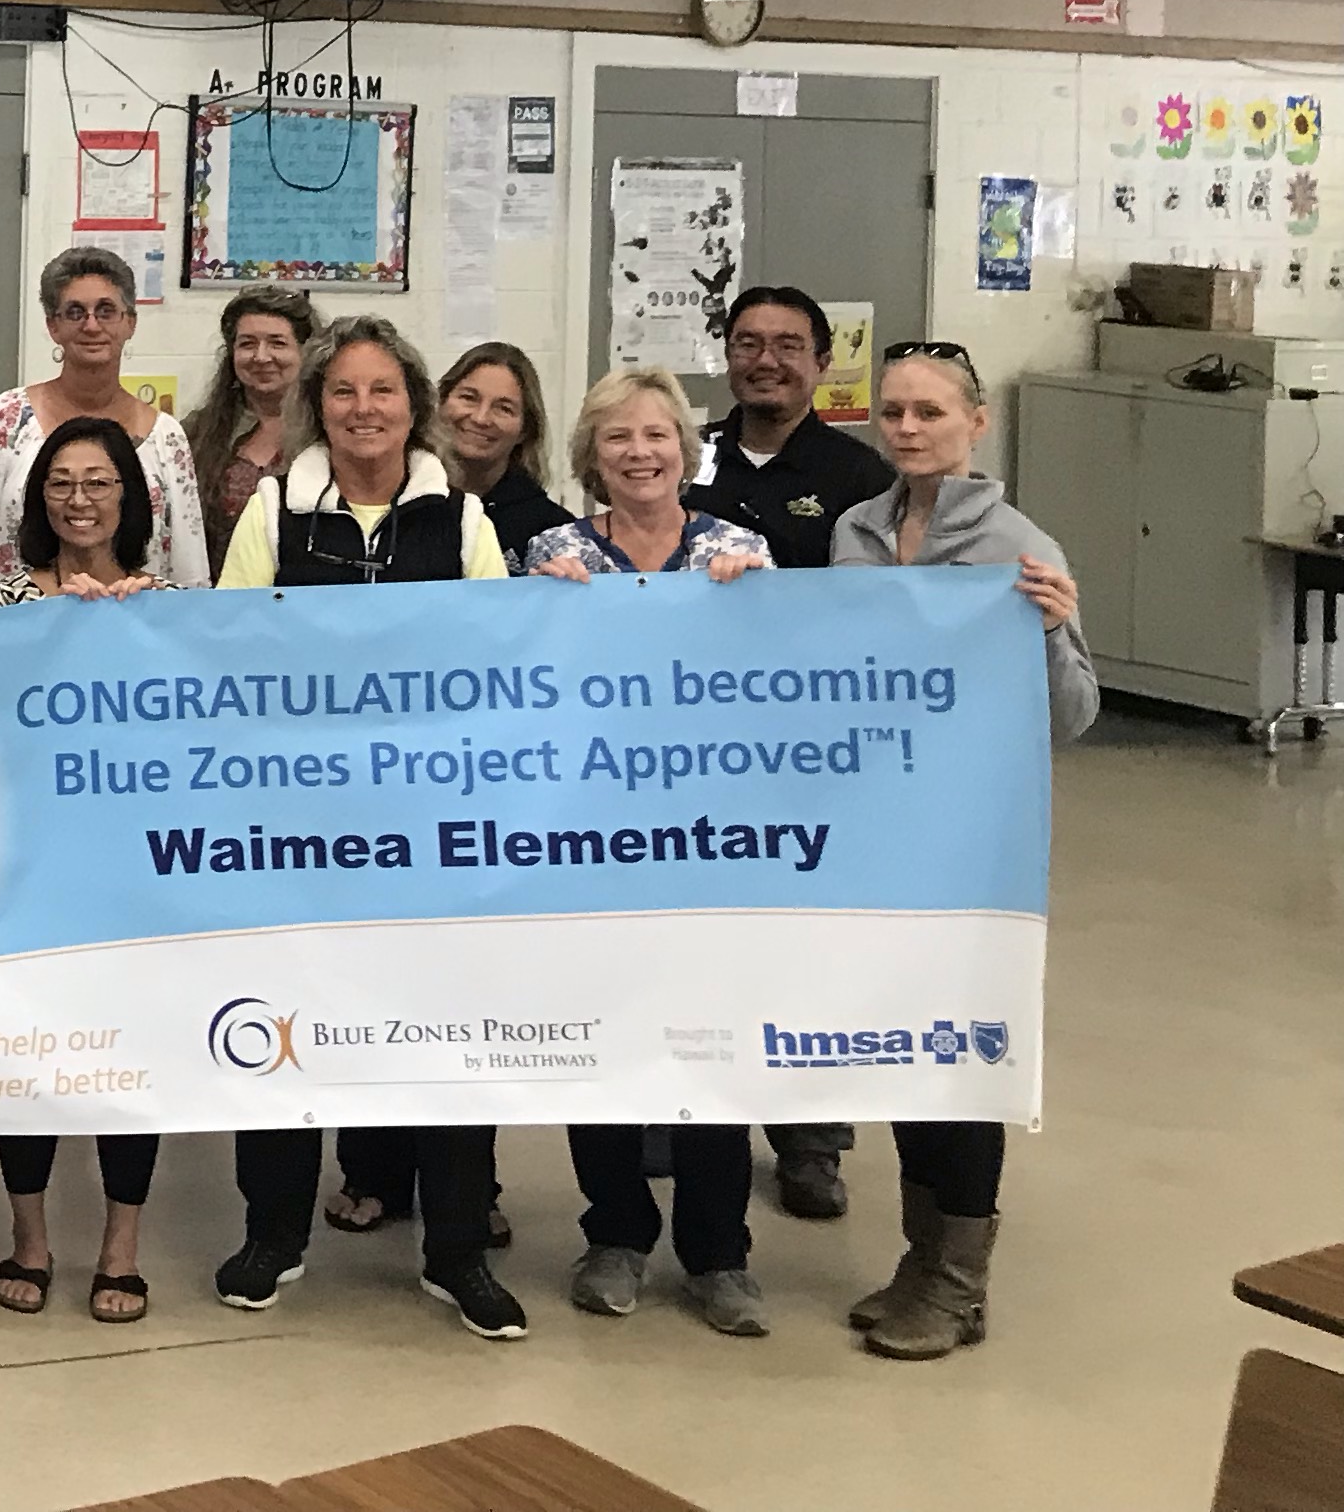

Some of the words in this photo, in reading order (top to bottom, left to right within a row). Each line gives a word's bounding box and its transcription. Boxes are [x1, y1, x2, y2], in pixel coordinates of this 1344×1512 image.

[258, 71, 382, 100] PROGRAM
[514, 106, 549, 121] PASS
[17, 665, 558, 728] CONGRATULATIONS
[580, 676, 653, 708] on
[673, 657, 957, 712] becoming
[54, 750, 171, 796] Blue
[189, 744, 350, 791] Zones
[371, 739, 560, 796] Project
[146, 826, 413, 875] Waimea
[438, 815, 831, 871] Elementary
[68, 1026, 122, 1051] our
[312, 1021, 377, 1048] BLUE
[385, 1018, 472, 1044] ZONES
[763, 1023, 914, 1056] hmsa
[464, 1053, 484, 1072] by
[488, 1050, 599, 1069] HEALTHWAYS
[54, 1066, 152, 1096] better.
